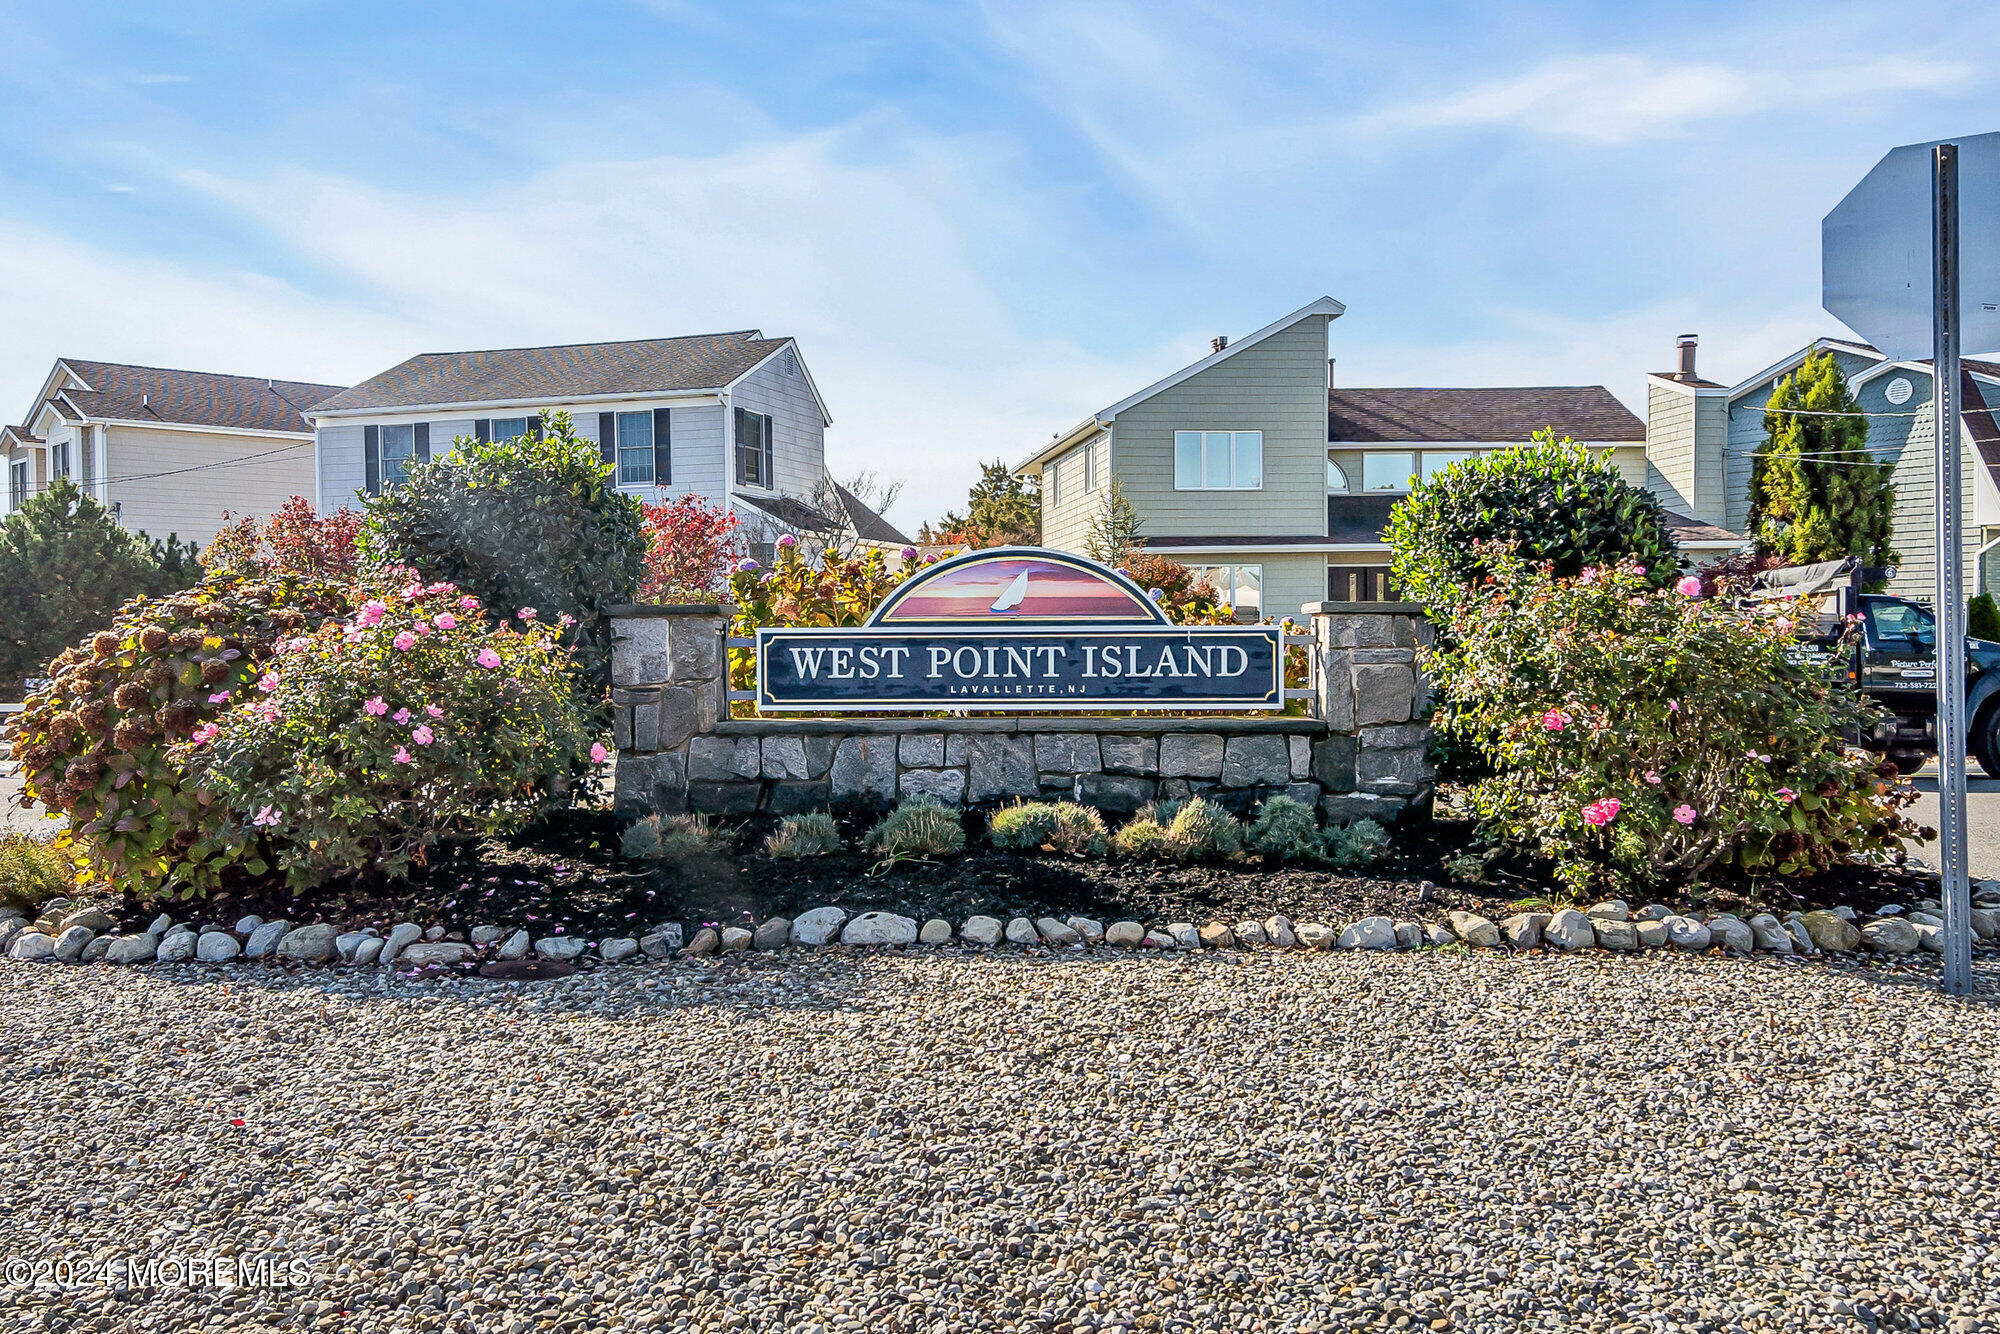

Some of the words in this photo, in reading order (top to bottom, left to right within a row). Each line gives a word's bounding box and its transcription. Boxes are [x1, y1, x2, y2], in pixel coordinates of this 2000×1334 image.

[788, 646, 910, 680] WEST
[926, 645, 1067, 680] POINT
[1081, 644, 1249, 679] ISLAND
[1891, 659, 1918, 668] Picture
[1918, 660, 1937, 670] Perf
